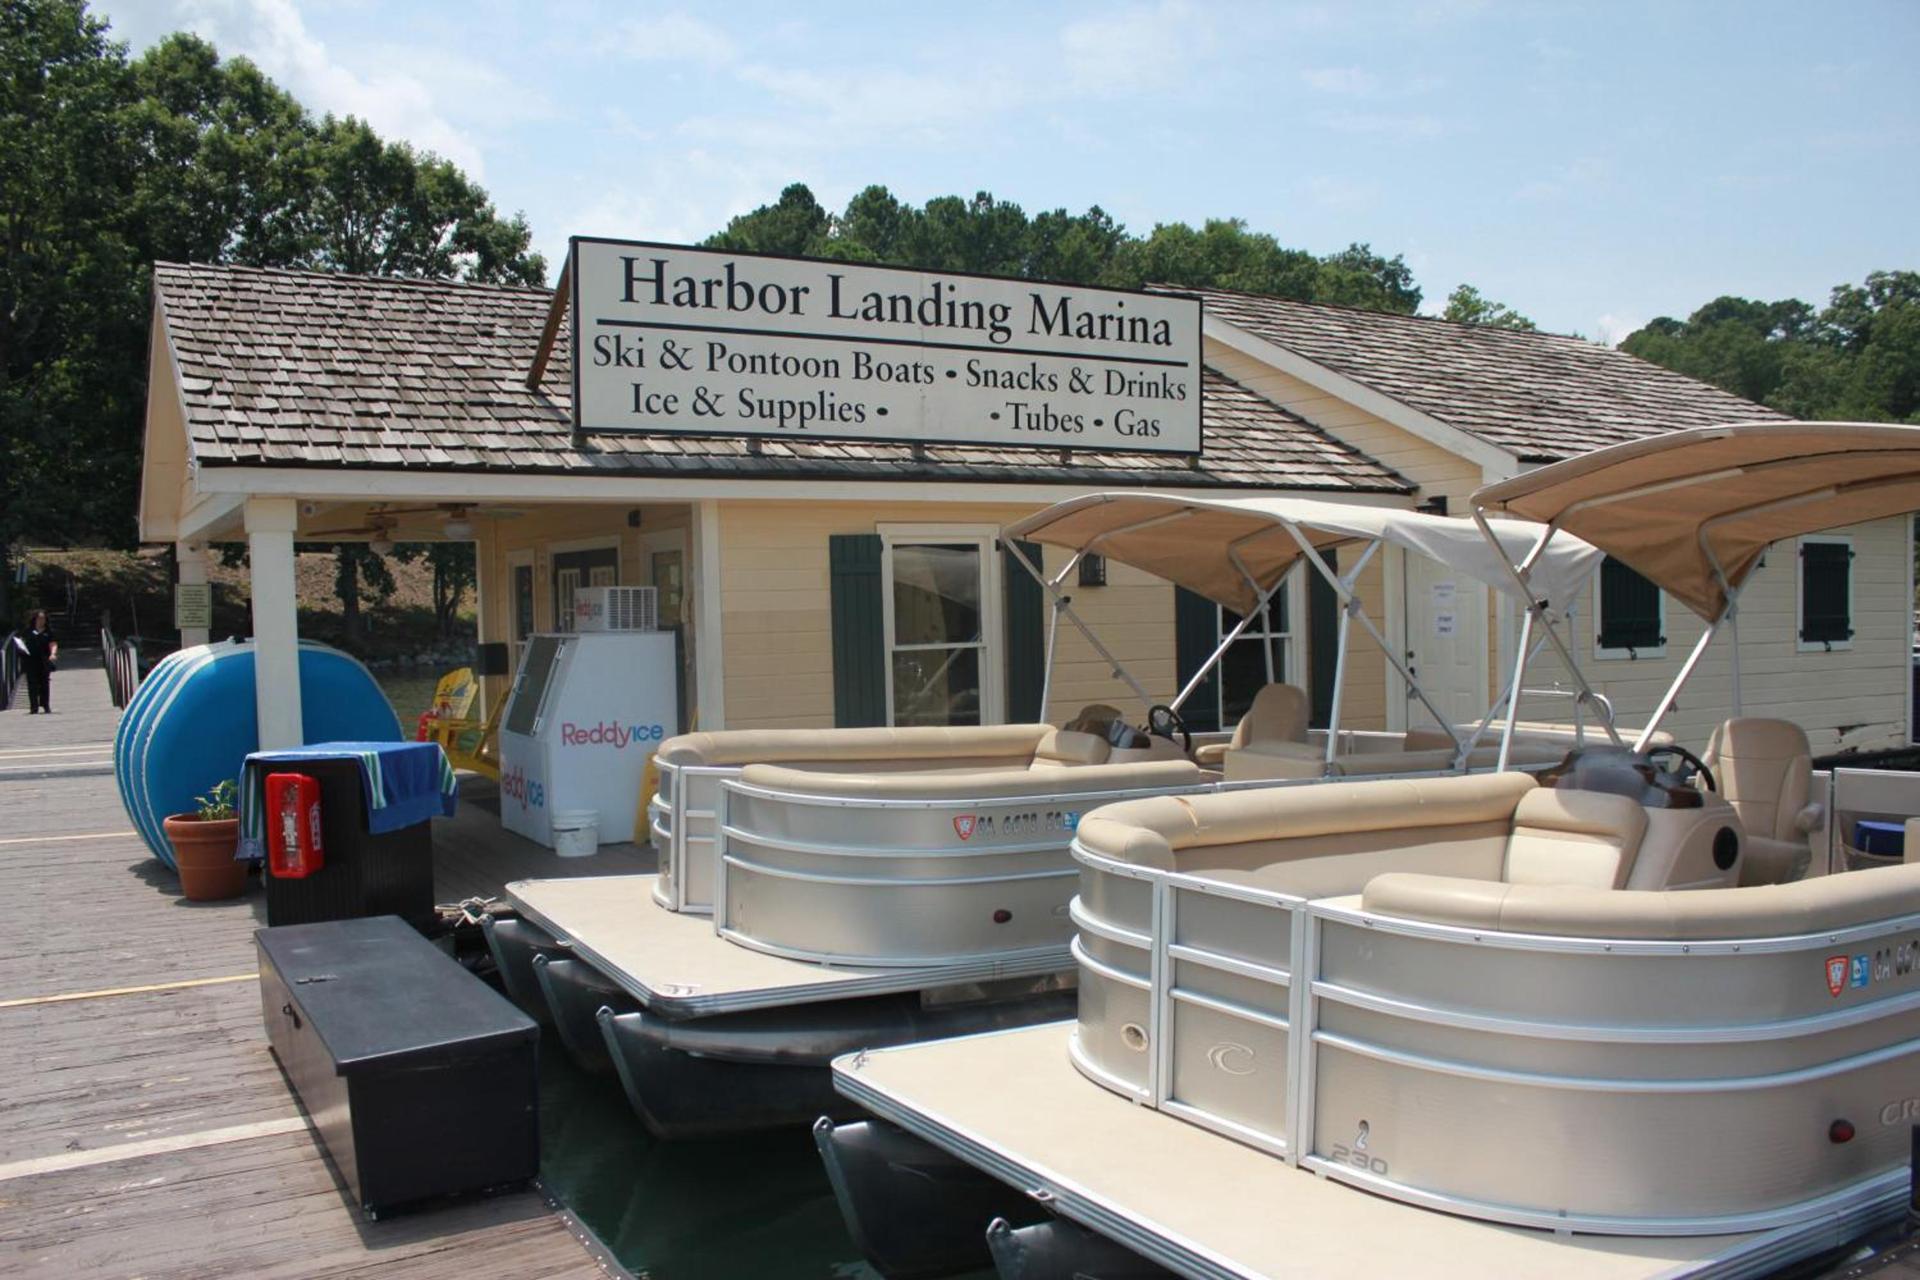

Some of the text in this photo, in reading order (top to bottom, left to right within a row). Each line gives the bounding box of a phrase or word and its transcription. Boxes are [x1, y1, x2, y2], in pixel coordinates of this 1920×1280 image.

[619, 256, 1173, 346] Harbor Landing Marina
[593, 334, 1187, 401] Ski & Pontoon Boats Snacks & Drinks
[631, 382, 1161, 437] Ice & Supplies Tubes Gas
[1331, 1143, 1388, 1176] 230
